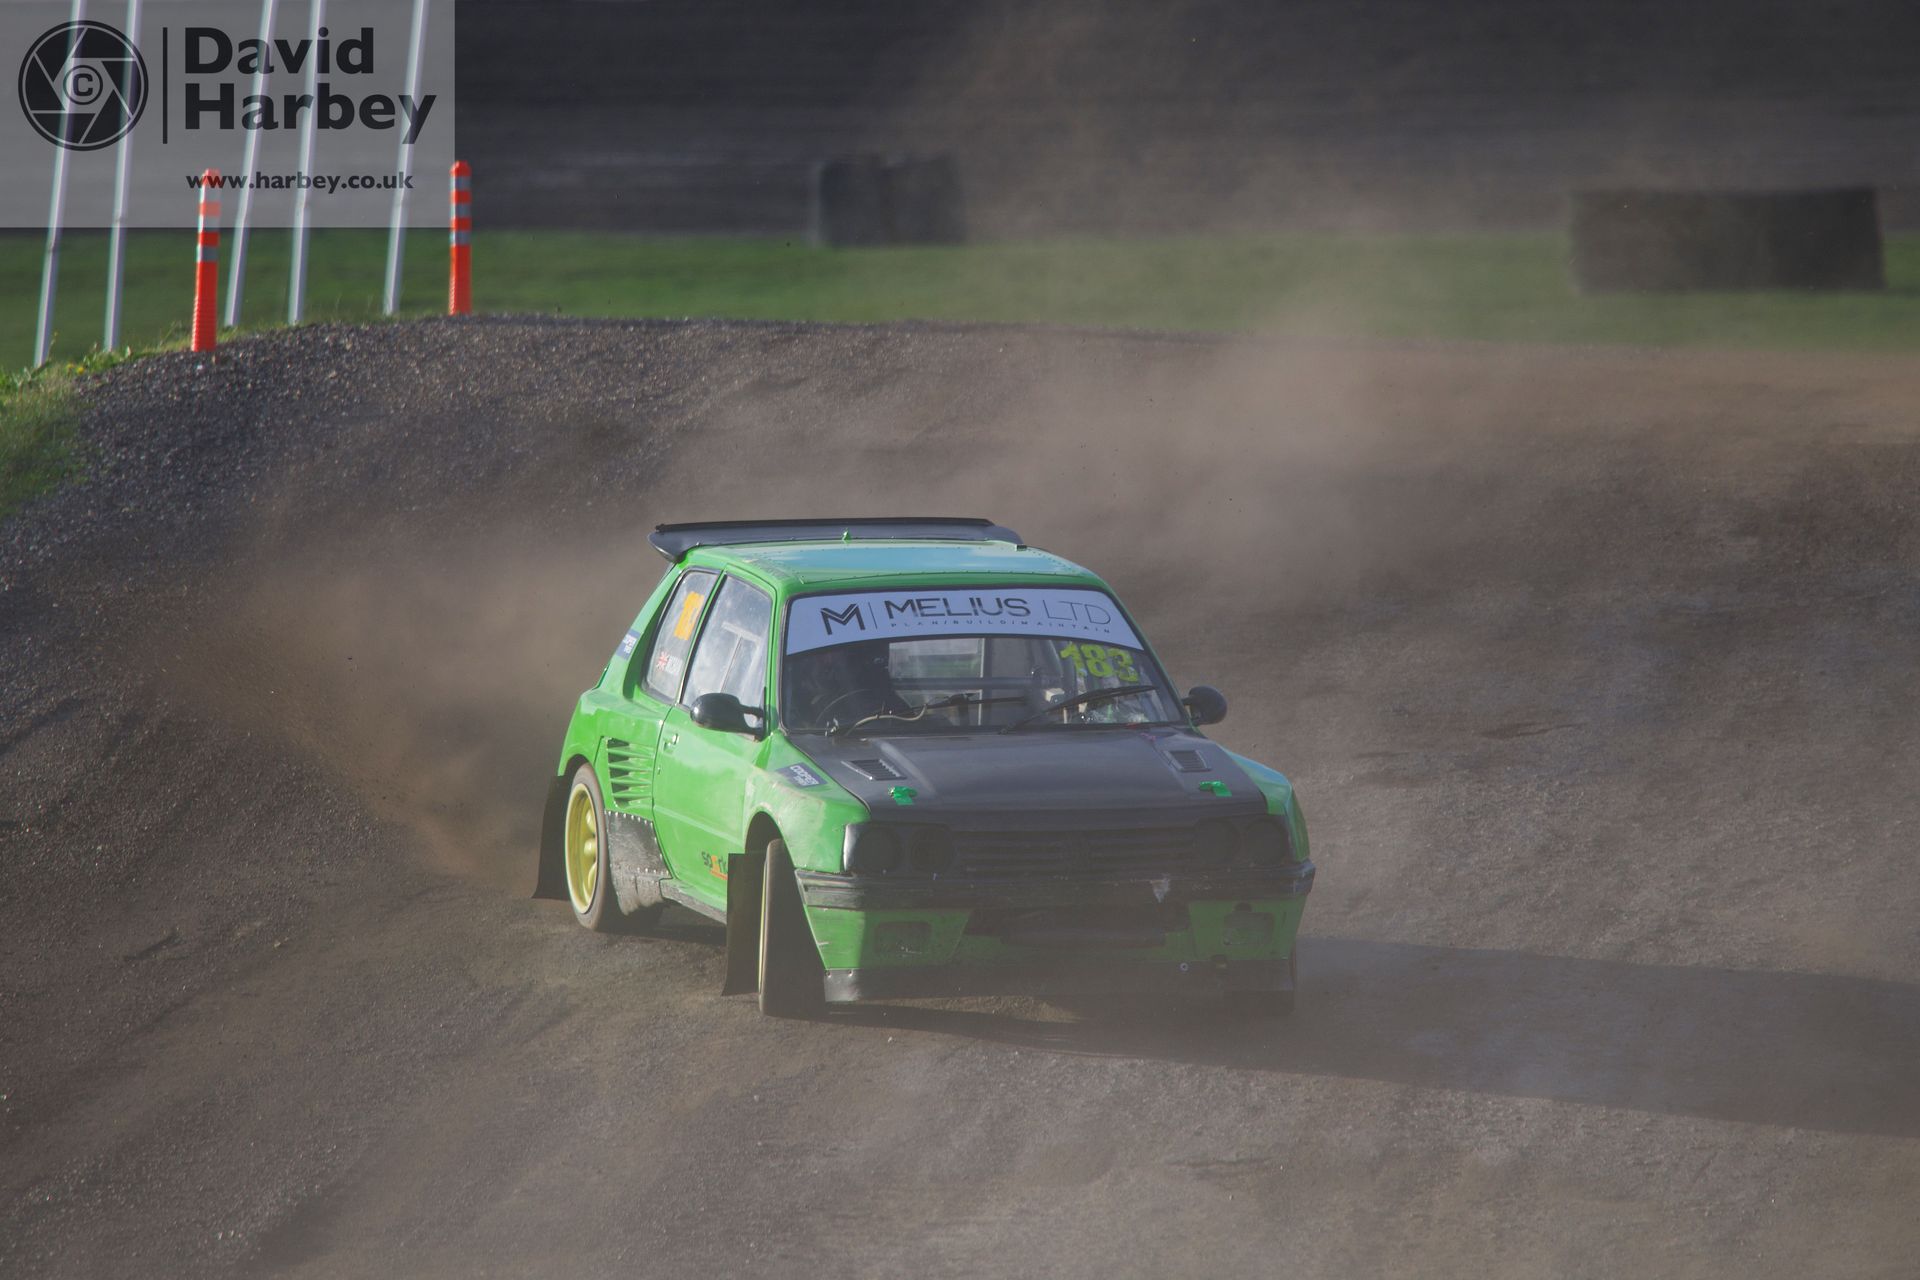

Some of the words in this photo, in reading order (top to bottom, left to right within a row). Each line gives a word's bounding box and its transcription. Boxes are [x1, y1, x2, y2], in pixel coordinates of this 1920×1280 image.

[884, 597, 1031, 619] MELIUS
[1042, 599, 1111, 625] LTD
[1061, 641, 1139, 683] 183
